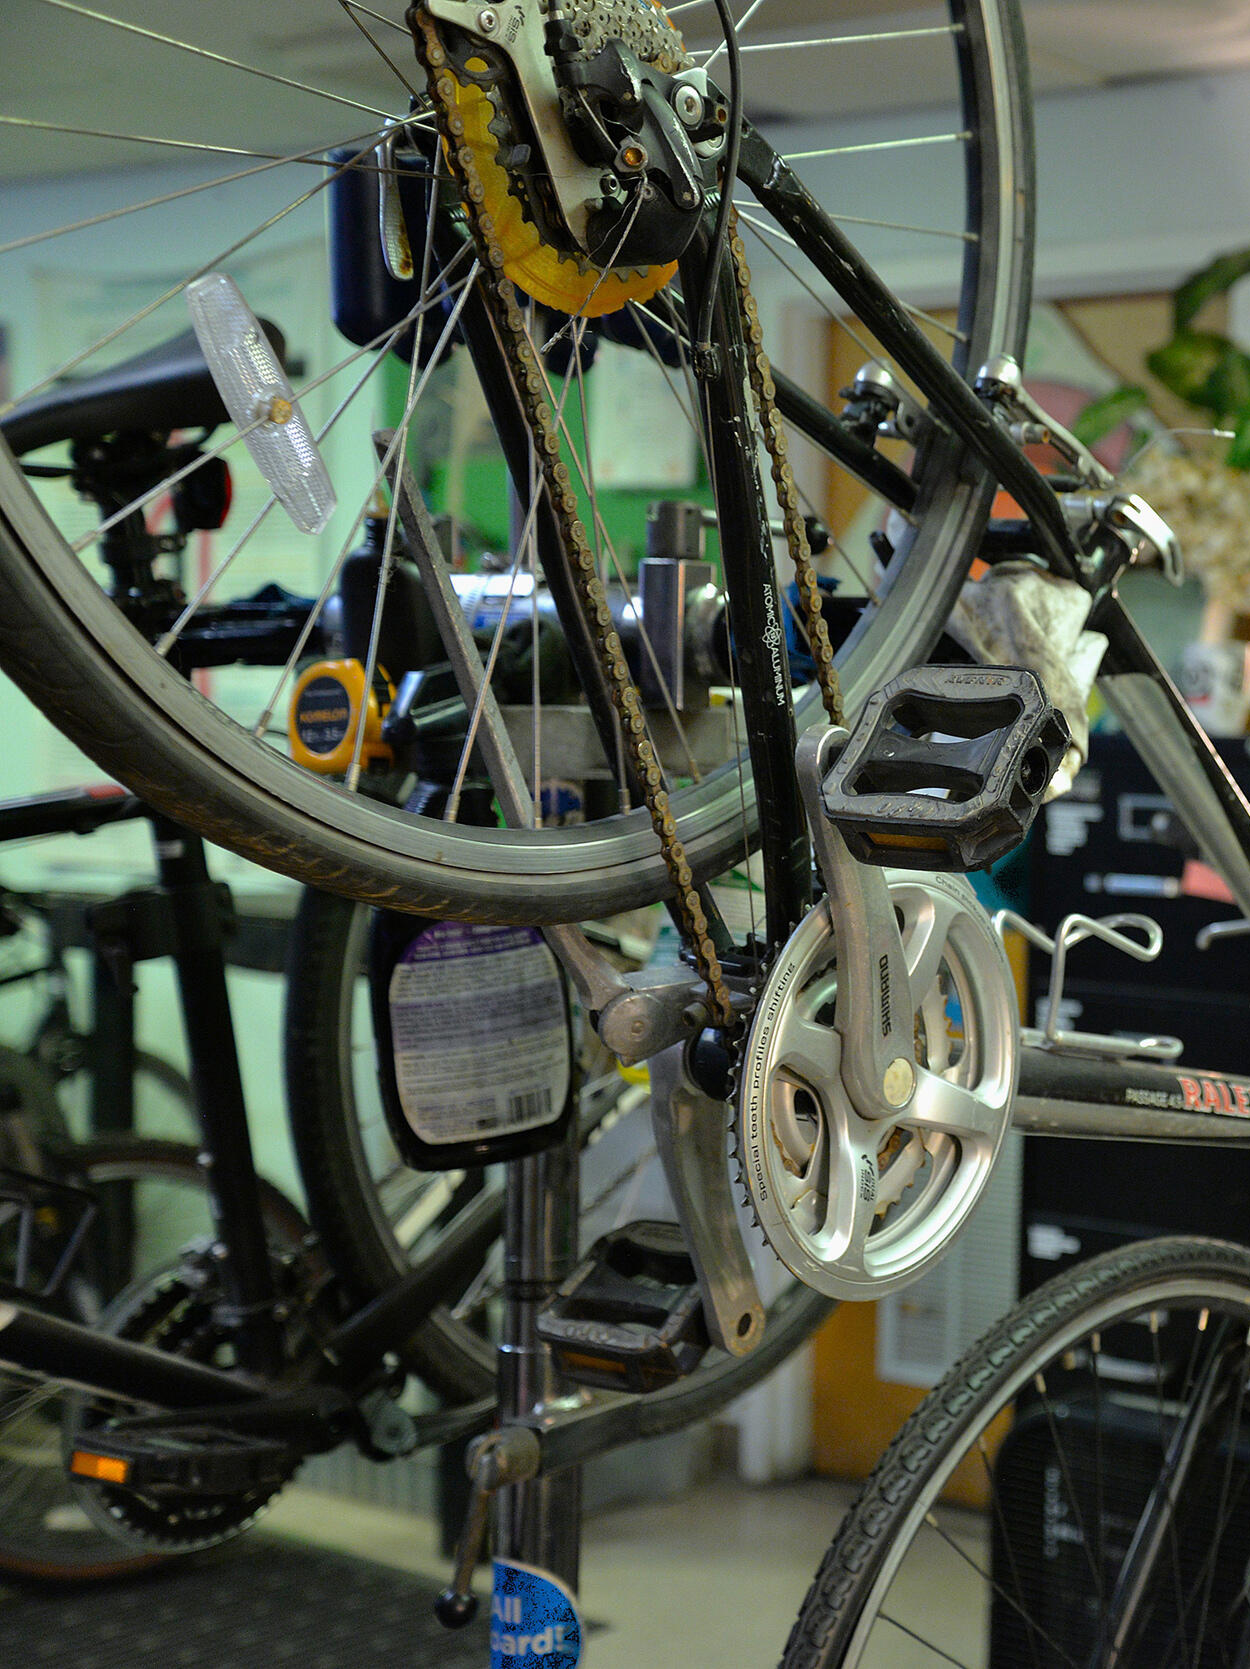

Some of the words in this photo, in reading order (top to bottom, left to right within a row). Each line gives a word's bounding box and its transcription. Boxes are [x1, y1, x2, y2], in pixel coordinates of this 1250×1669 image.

[763, 583, 776, 626] ATOMIC
[771, 647, 786, 706] ALUMINUM
[767, 962, 796, 1022] shifting
[879, 954, 892, 1037] SHIMANO
[752, 1026, 770, 1089] profiles
[751, 1144, 768, 1202] Special
